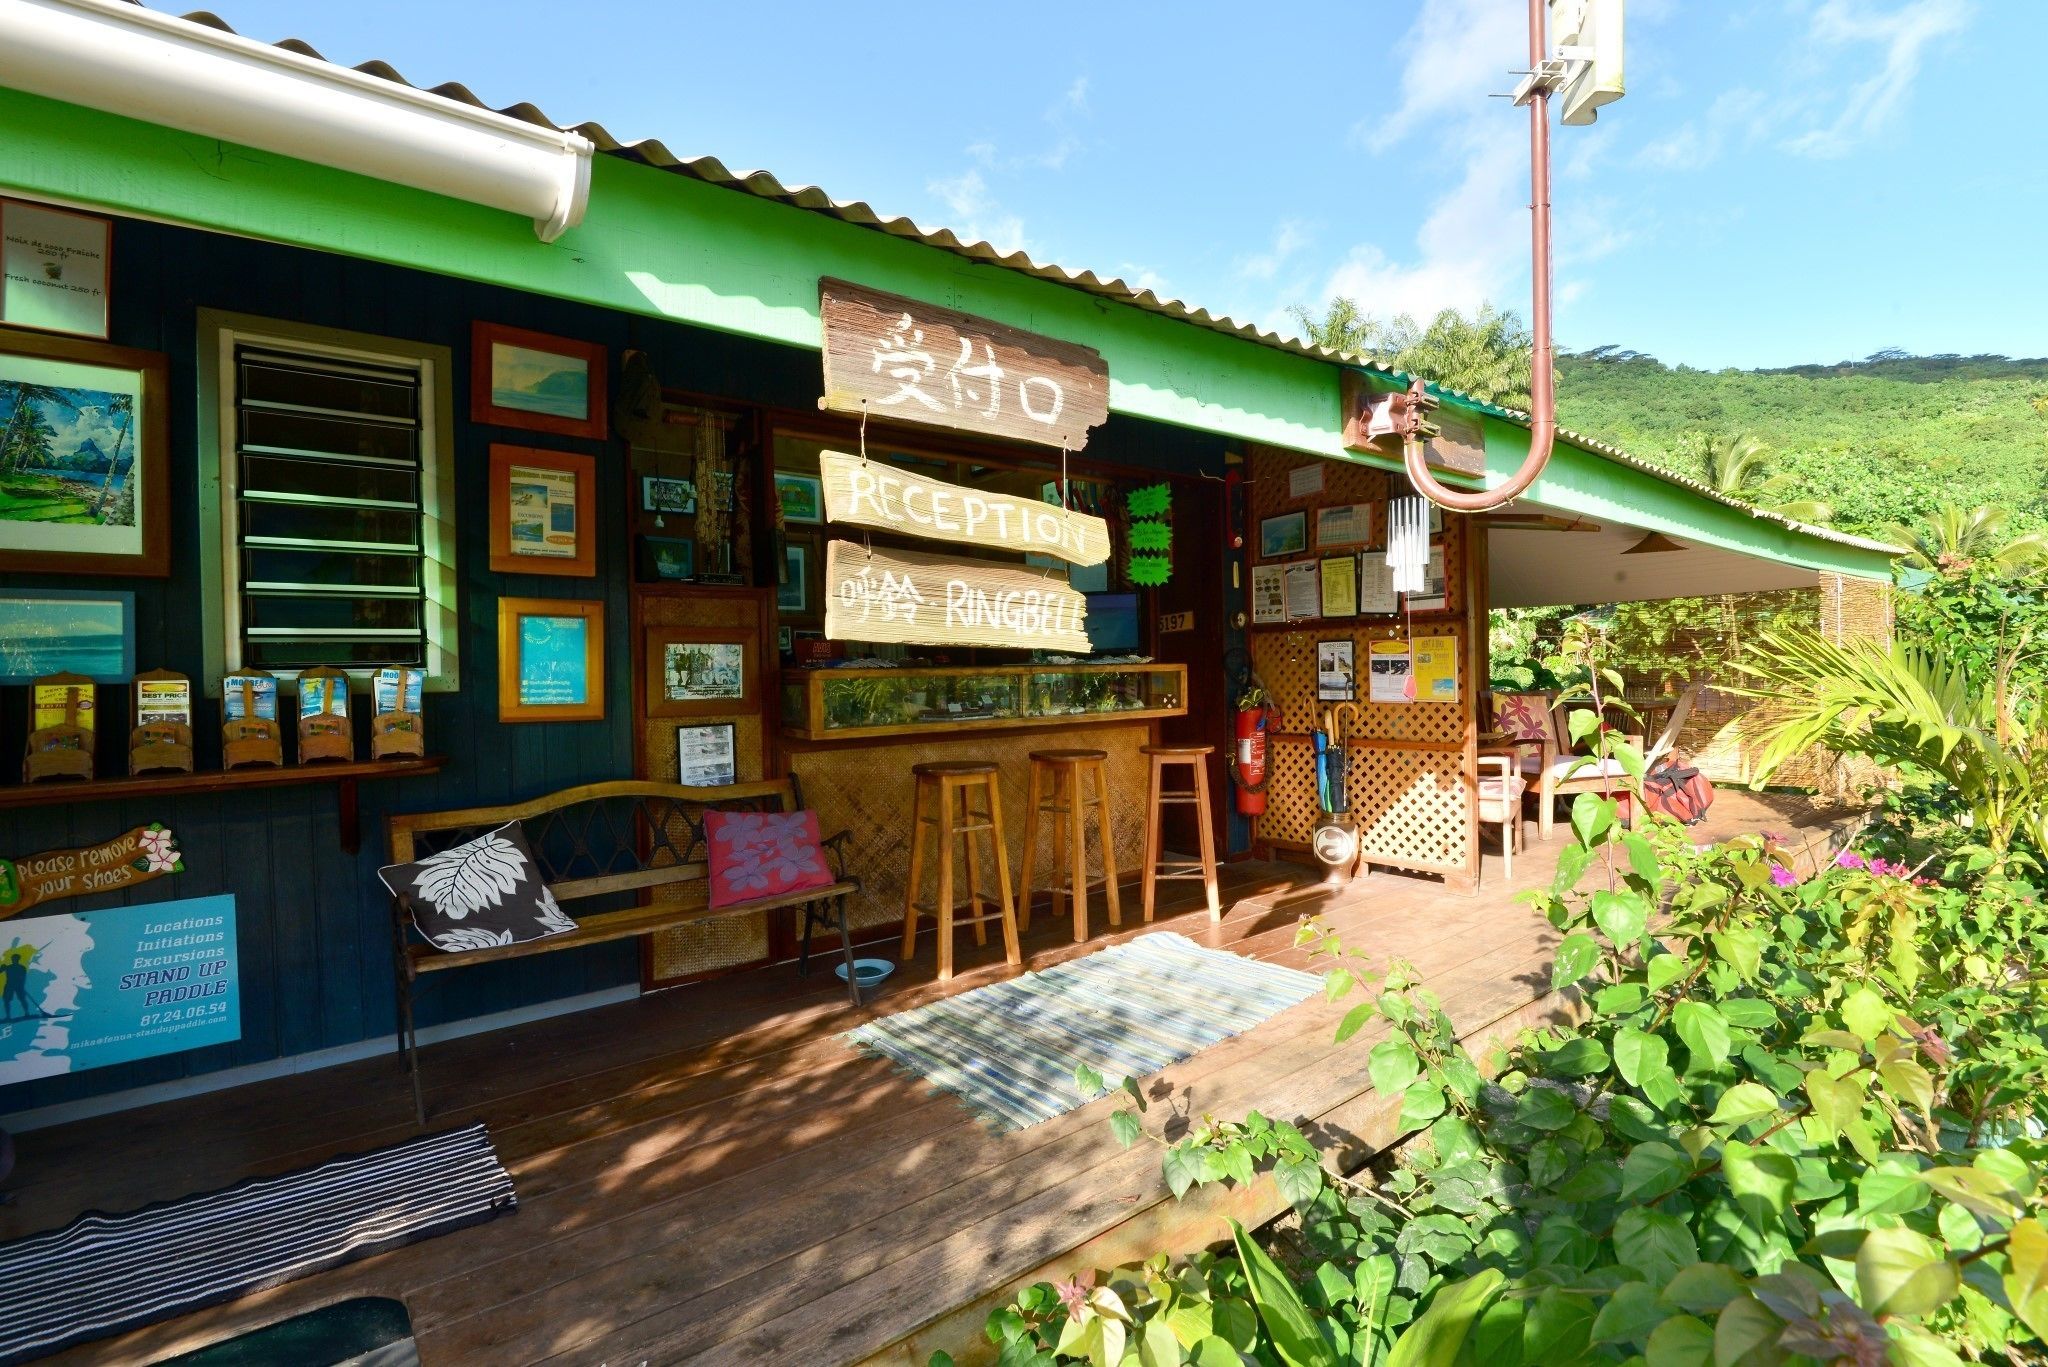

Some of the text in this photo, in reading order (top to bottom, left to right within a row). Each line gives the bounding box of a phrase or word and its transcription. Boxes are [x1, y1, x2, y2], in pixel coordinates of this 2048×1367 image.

[37, 248, 58, 257] 250
[4, 273, 30, 283] Fresh
[32, 279, 69, 290] coconut
[70, 285, 90, 294] 250
[871, 312, 1065, 426] 受付口
[849, 468, 1087, 552] RECEPTION
[945, 578, 1081, 637] RINGBELL
[80, 836, 137, 867] remove
[32, 864, 133, 903] your shoes
[143, 916, 224, 935] Locations
[136, 931, 225, 953] Initiations
[133, 947, 225, 970] Excursions
[119, 959, 228, 991] STAND UP
[143, 979, 229, 1008] PADDLE
[140, 1001, 228, 1027] 87.24.06.54
